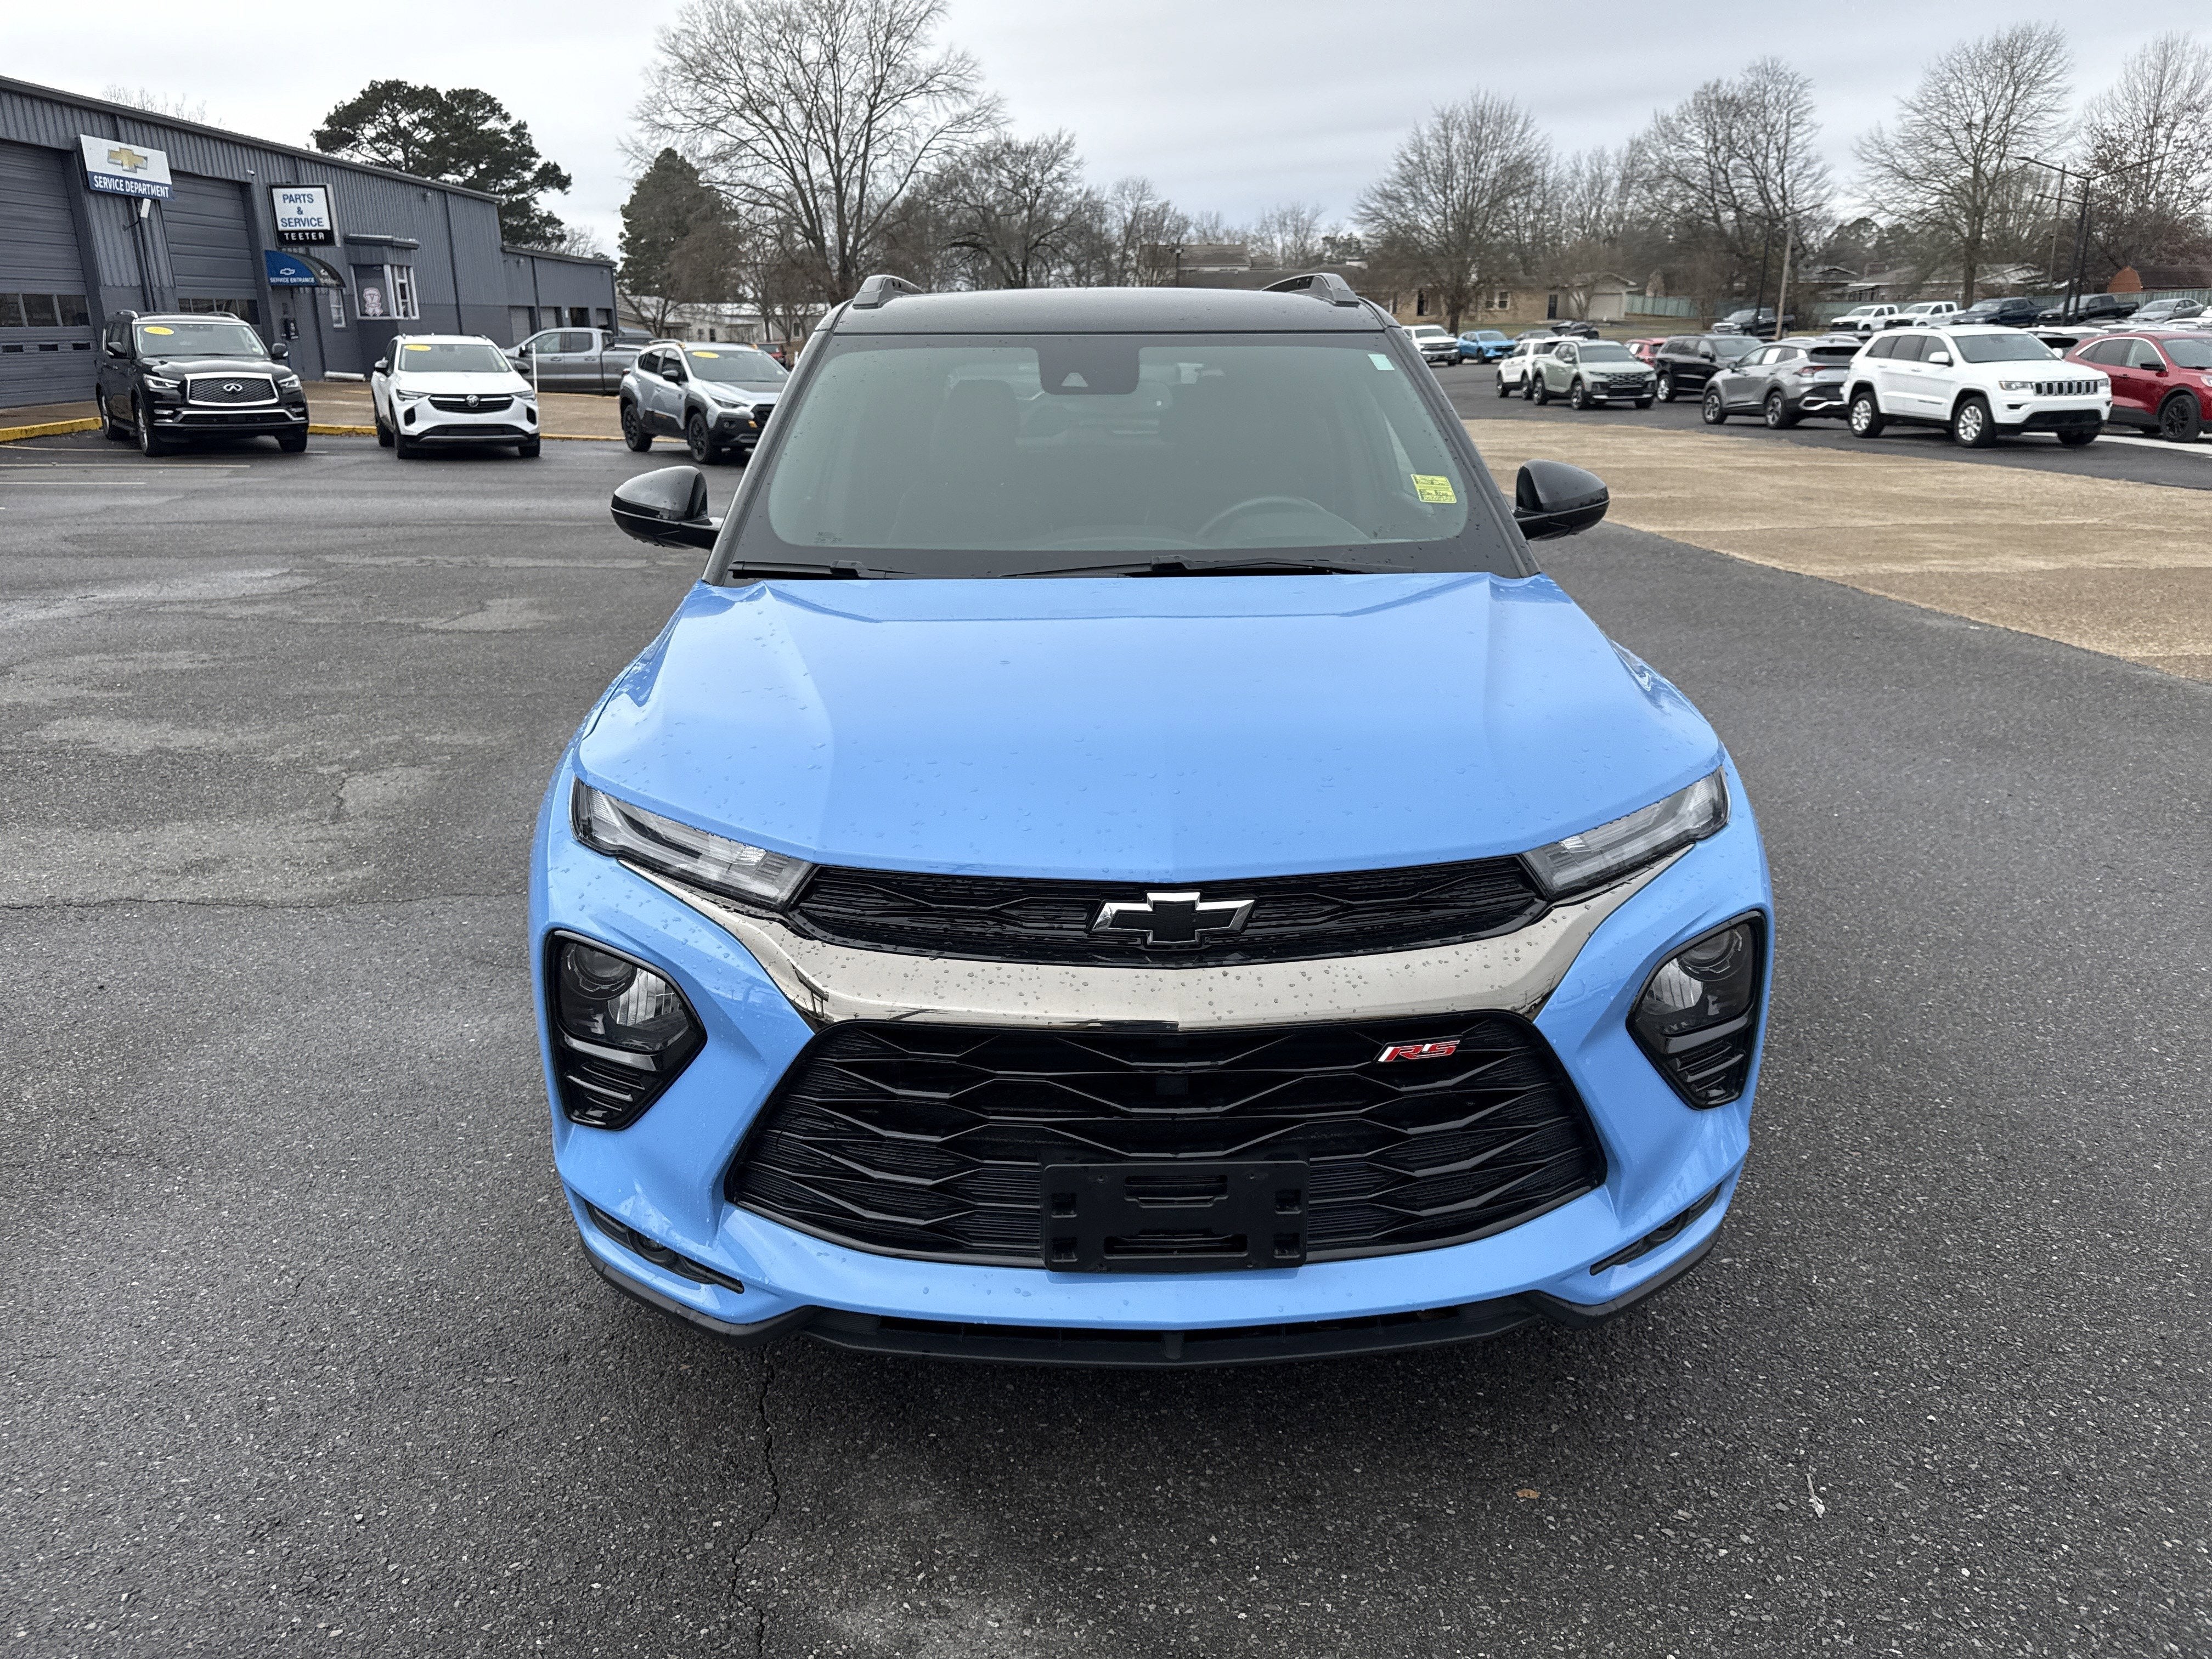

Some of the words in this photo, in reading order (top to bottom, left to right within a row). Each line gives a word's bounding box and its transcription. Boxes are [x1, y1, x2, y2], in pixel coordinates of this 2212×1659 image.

[94, 175, 125, 191] SERVICE
[125, 180, 169, 198] DEPARTMENT
[282, 194, 314, 204] PARTS
[296, 206, 303, 215] &
[280, 217, 324, 228] SERVICE
[284, 232, 325, 240] TEETER
[1378, 1040, 1460, 1062] RS
